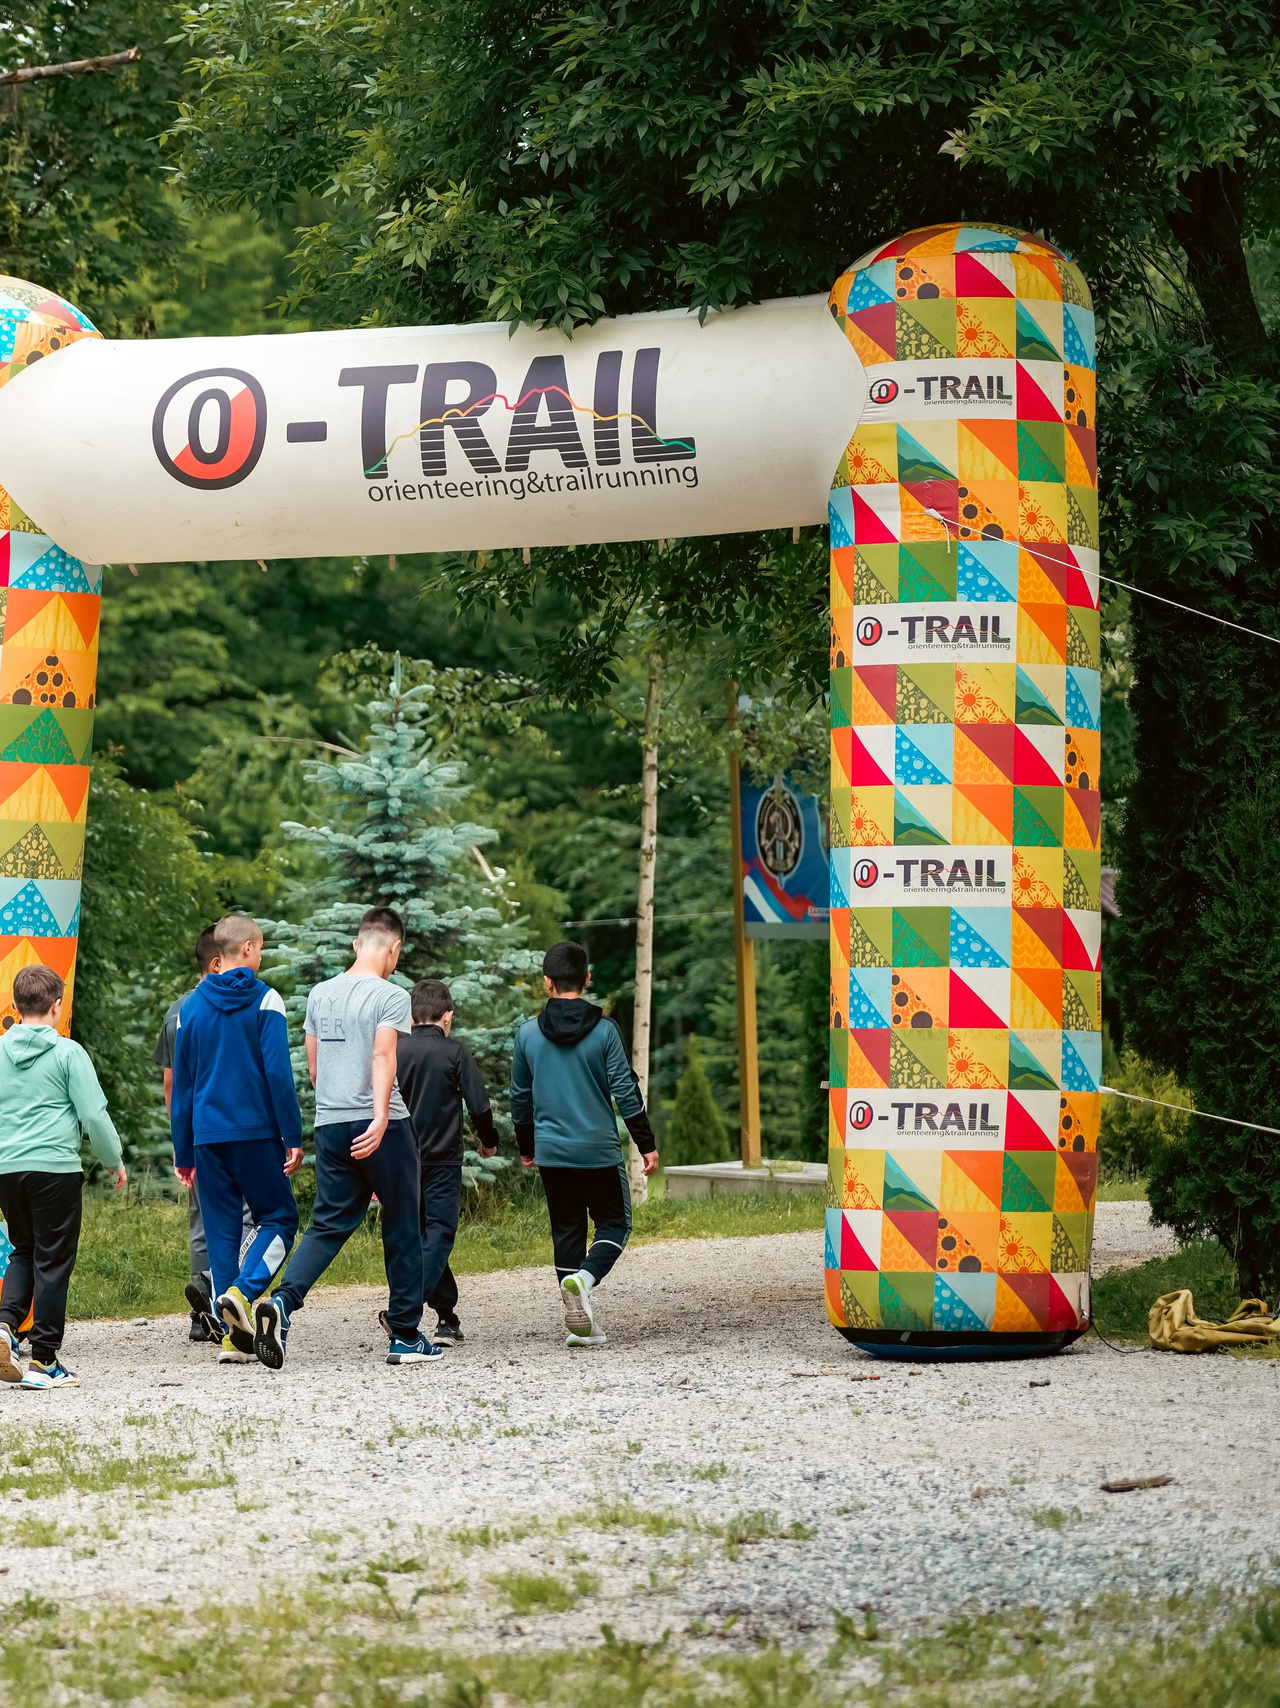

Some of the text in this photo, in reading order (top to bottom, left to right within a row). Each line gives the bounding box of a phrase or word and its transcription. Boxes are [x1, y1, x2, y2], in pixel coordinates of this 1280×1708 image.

[924, 398, 1013, 406] orienteering&trailrunning
[368, 463, 699, 502] orienteering&trailrunning
[908, 642, 1011, 651] orienteering&trailrunning
[903, 886, 1006, 894] orienteering&trailrunning
[897, 1130, 999, 1138] orienteering&trailrunning
